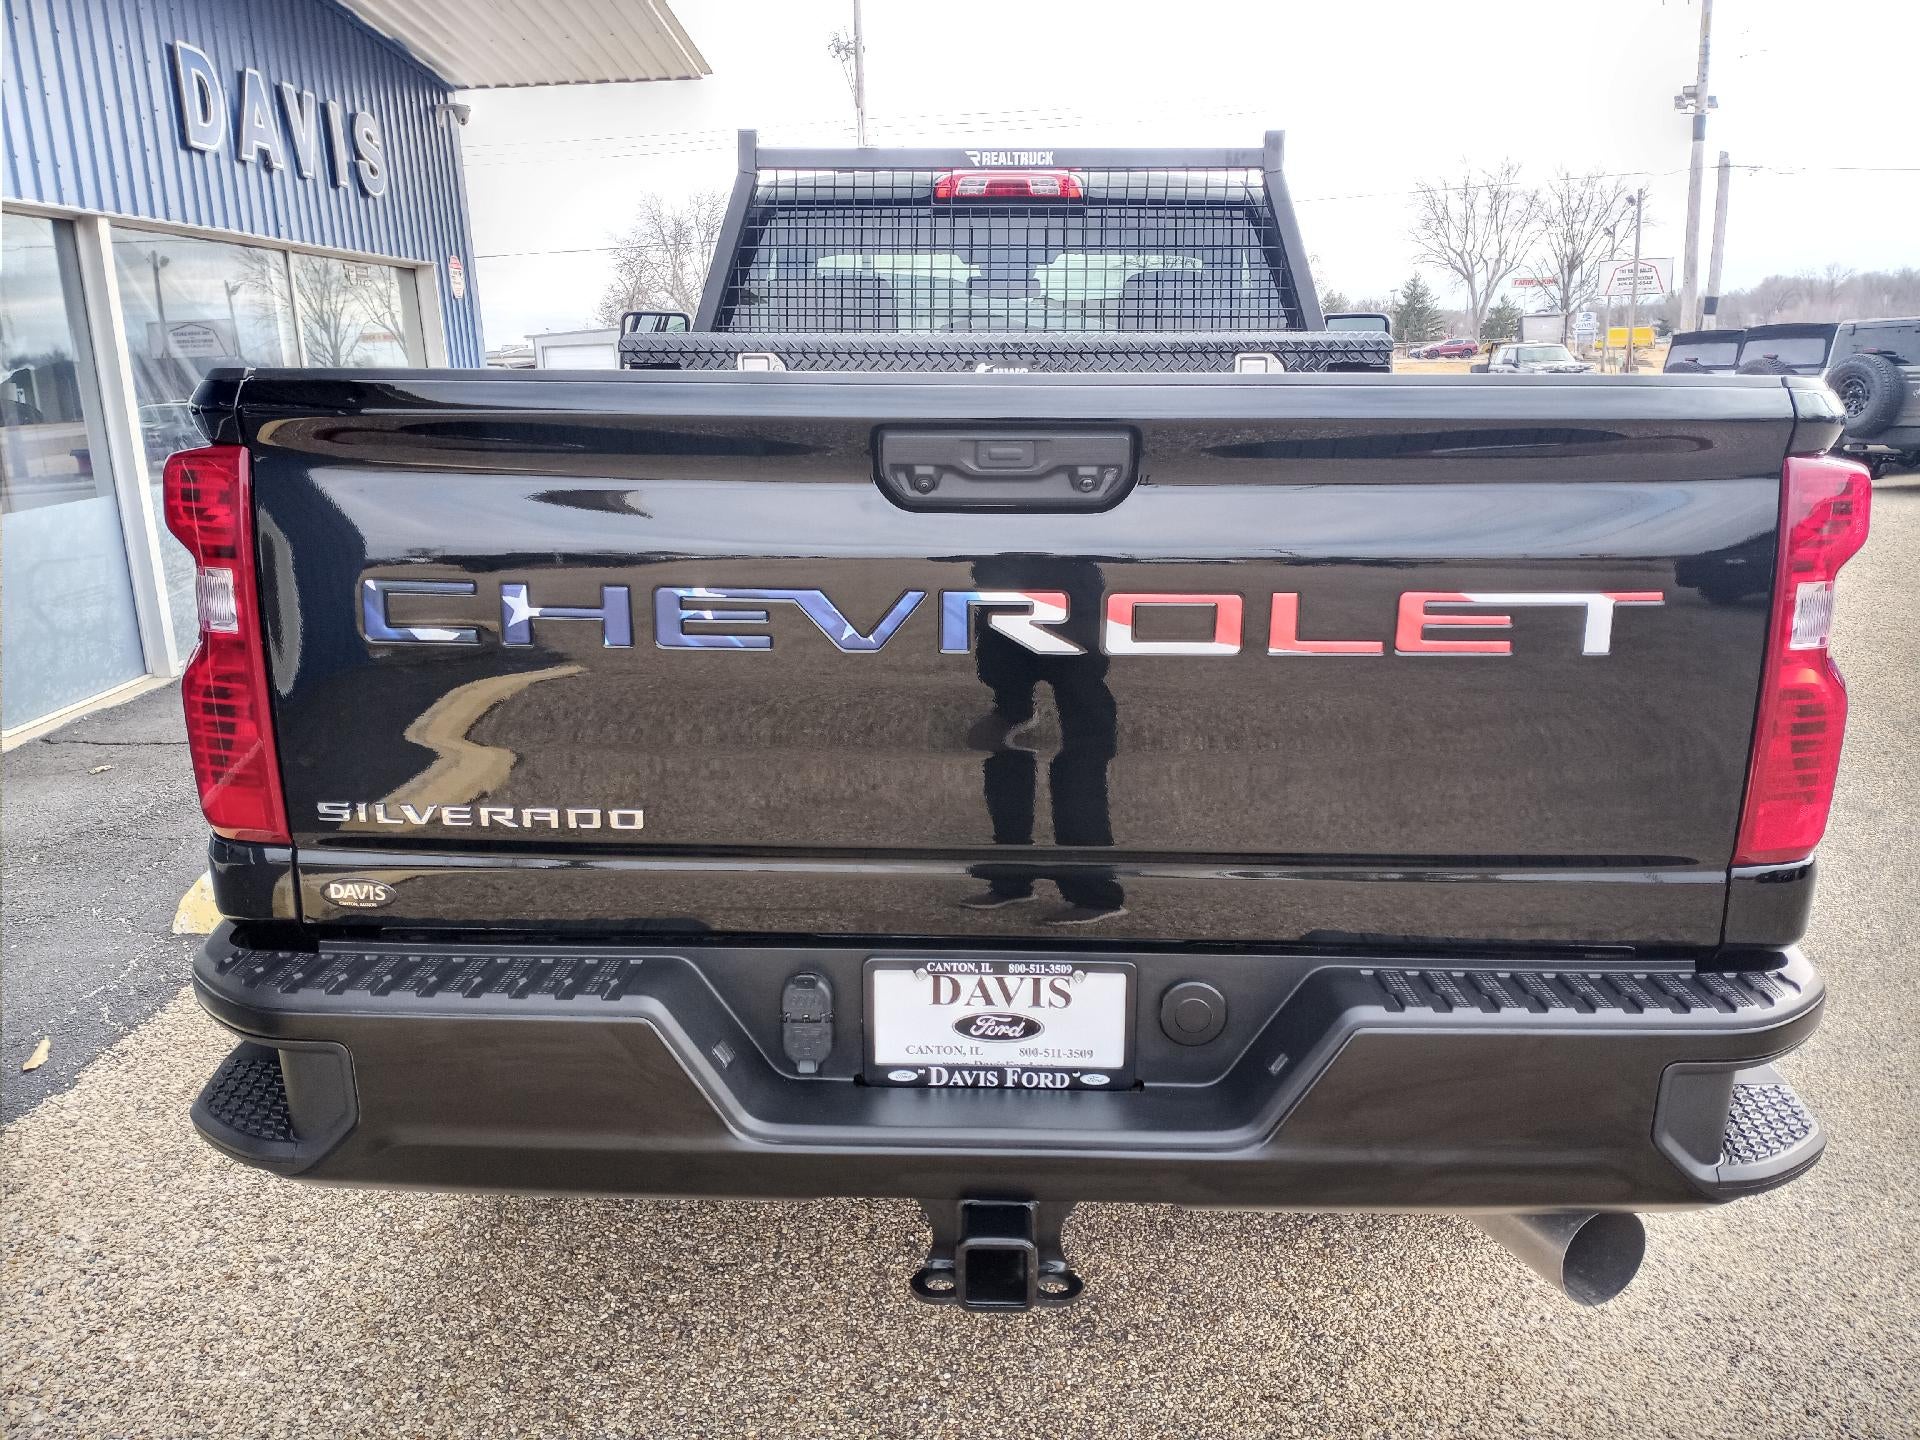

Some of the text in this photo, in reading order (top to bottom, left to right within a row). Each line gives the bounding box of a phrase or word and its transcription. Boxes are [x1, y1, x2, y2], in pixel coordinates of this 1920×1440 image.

[174, 39, 388, 199] DAVIS
[981, 151, 1054, 166] REALTRUCK
[362, 579, 1666, 657] CHEVROLET
[316, 801, 645, 831] SILVERADO
[329, 883, 386, 901] DAVIS
[926, 962, 1073, 975] CANTON, IL 800-511-3509
[928, 974, 1073, 1010] DAVIS
[969, 1015, 1026, 1038] Ford
[905, 1045, 1095, 1059] CANTON, IL 800-511-3509
[927, 1066, 1071, 1089] DAVIS FORD
